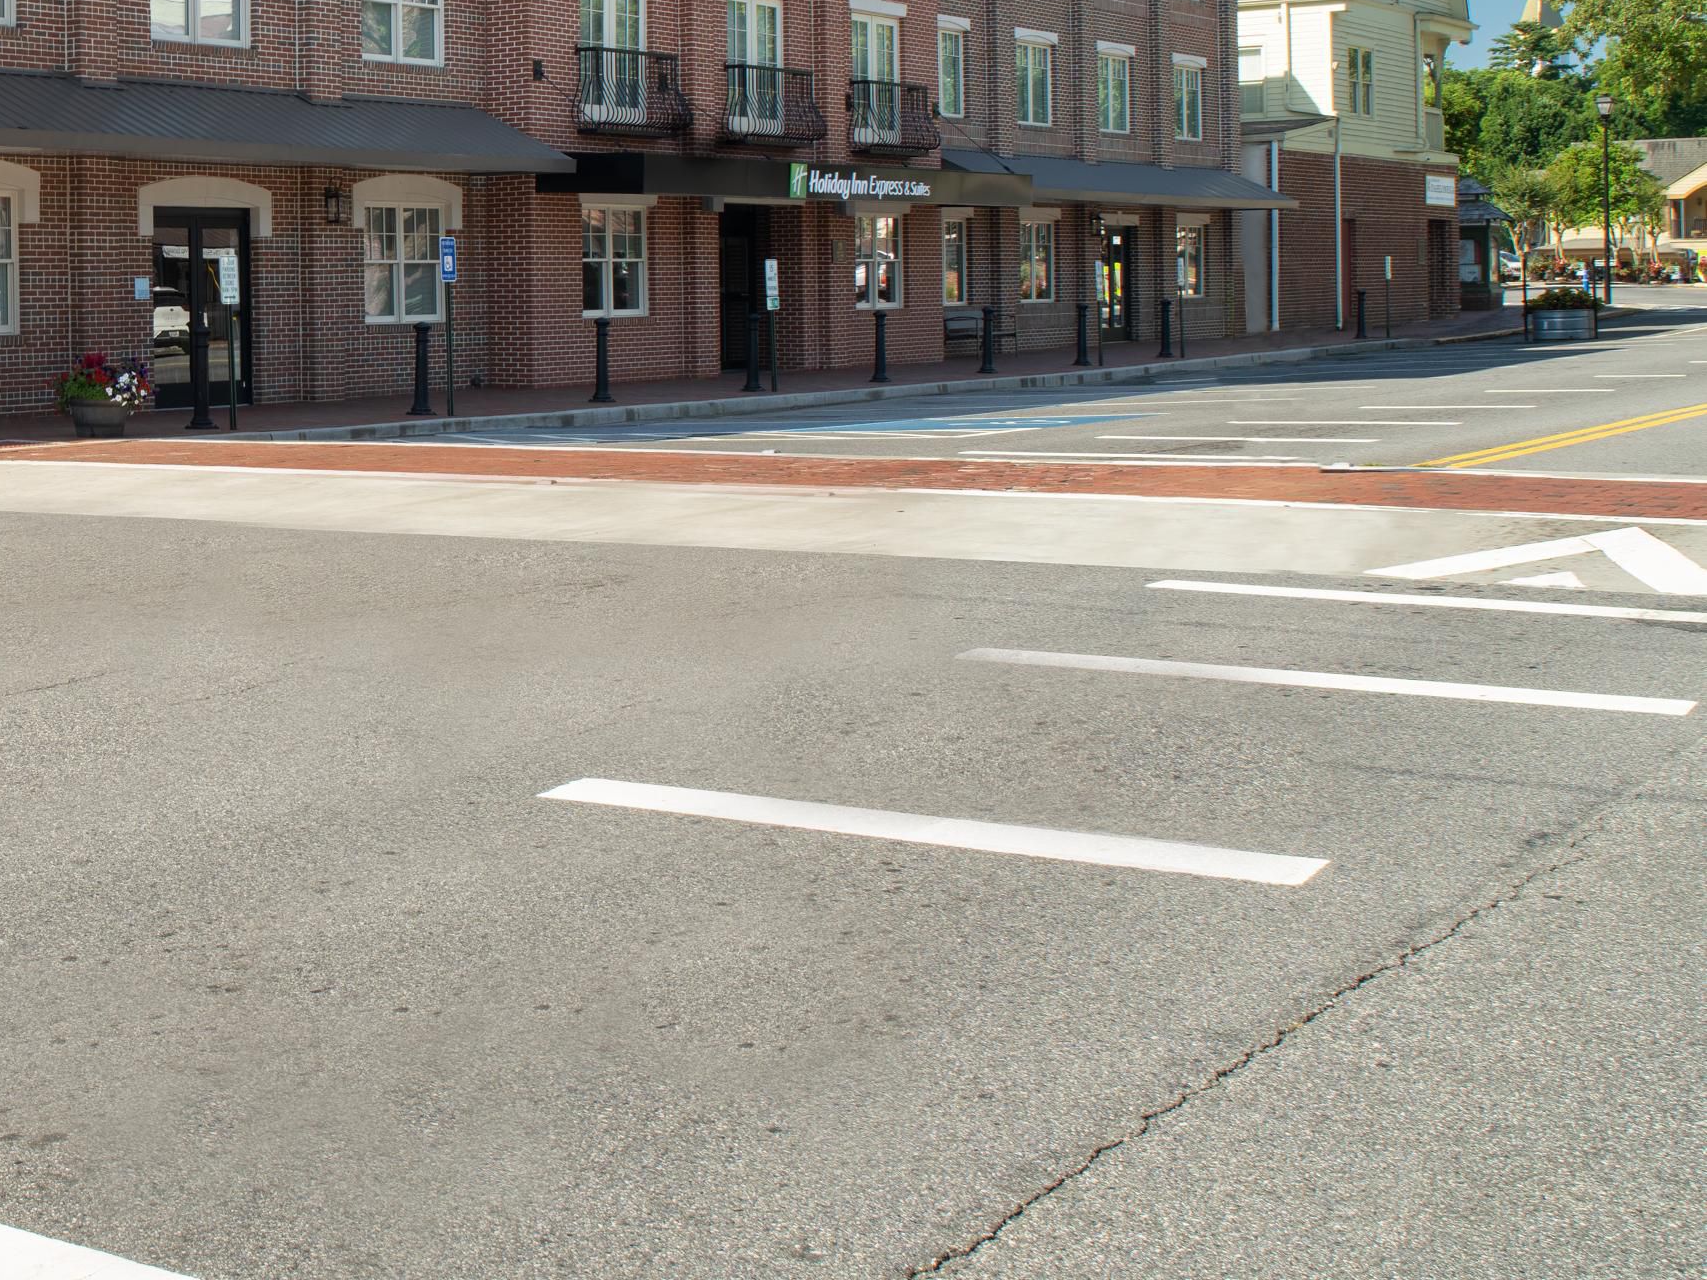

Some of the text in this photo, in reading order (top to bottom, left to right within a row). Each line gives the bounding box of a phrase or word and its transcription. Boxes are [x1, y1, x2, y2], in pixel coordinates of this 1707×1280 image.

[809, 170, 851, 199] Holiday
[851, 172, 869, 195] Inn
[869, 175, 904, 200] Express
[904, 181, 911, 195] &
[910, 181, 931, 196] Suites
